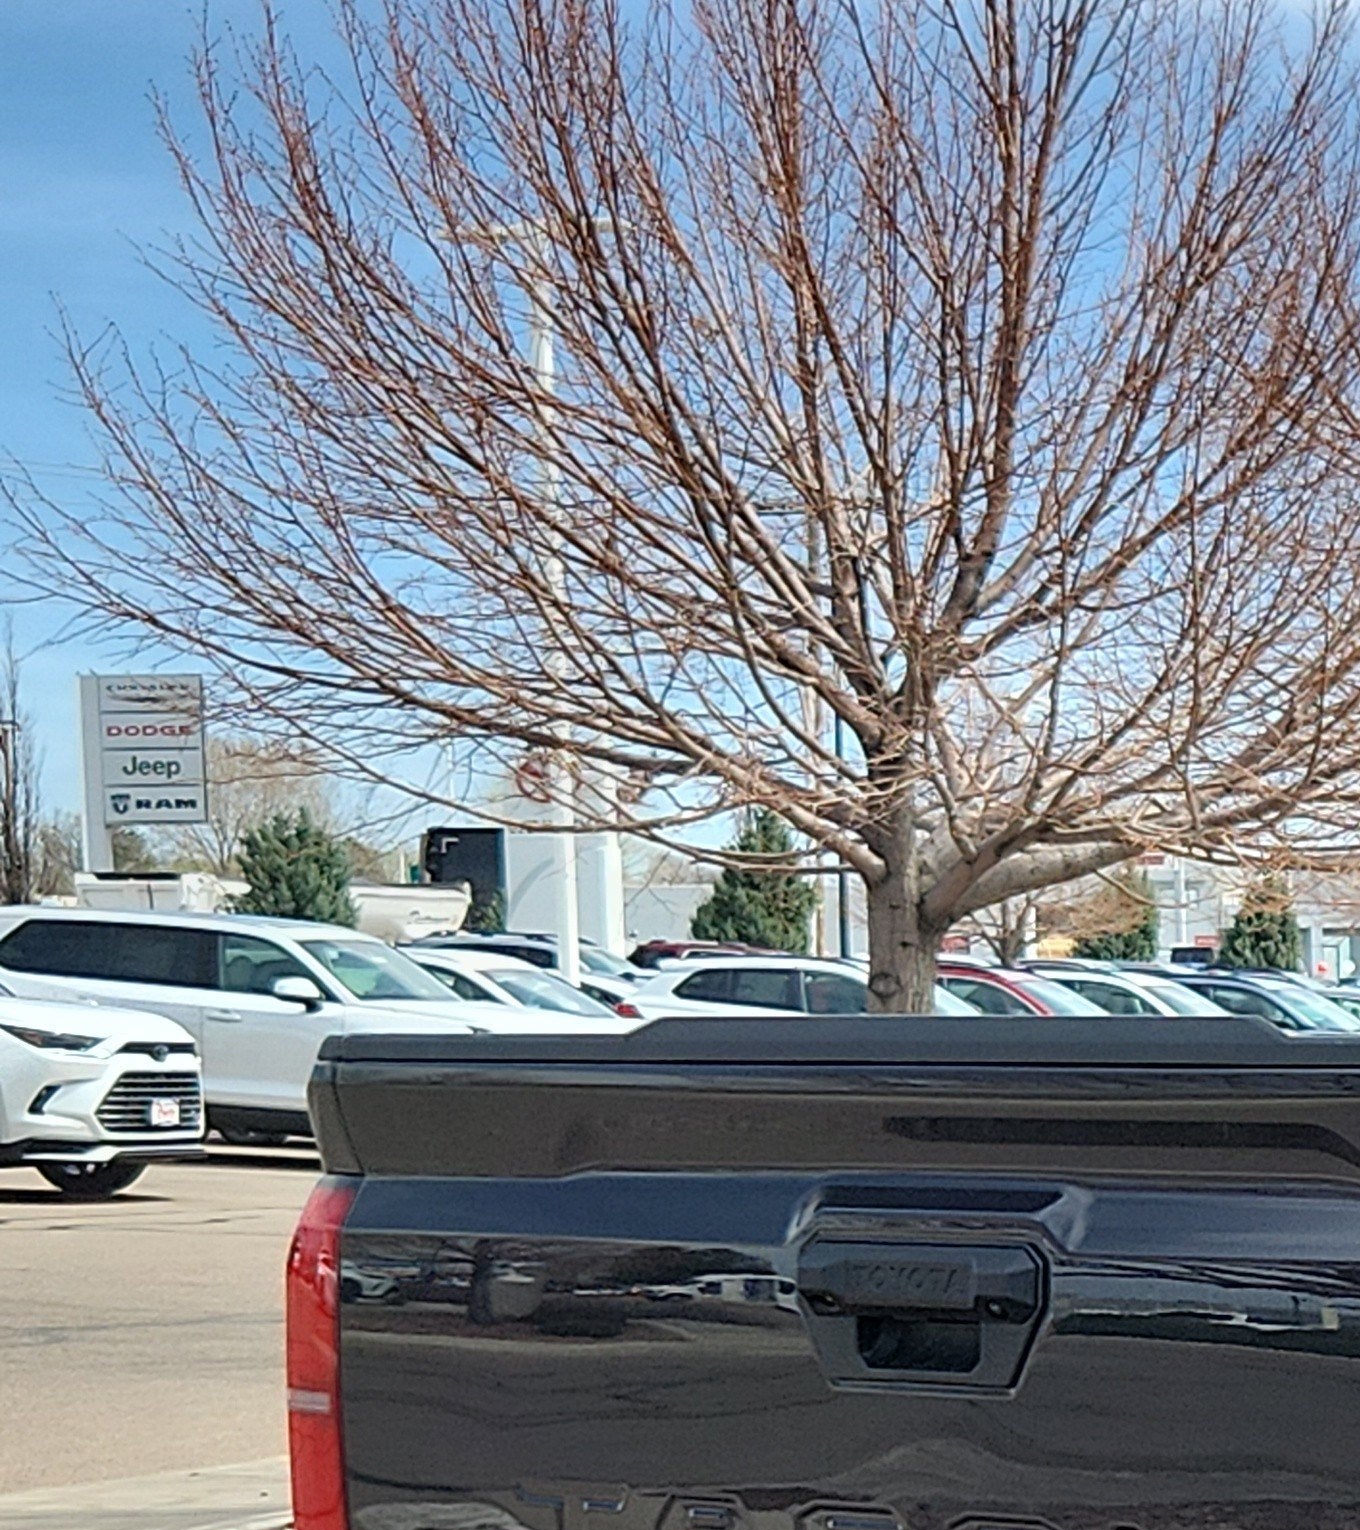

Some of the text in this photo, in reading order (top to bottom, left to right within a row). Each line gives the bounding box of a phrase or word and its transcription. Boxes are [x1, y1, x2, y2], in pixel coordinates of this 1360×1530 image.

[106, 725, 193, 737] DODGE
[122, 756, 181, 779] Jeep
[136, 798, 197, 809] RAM
